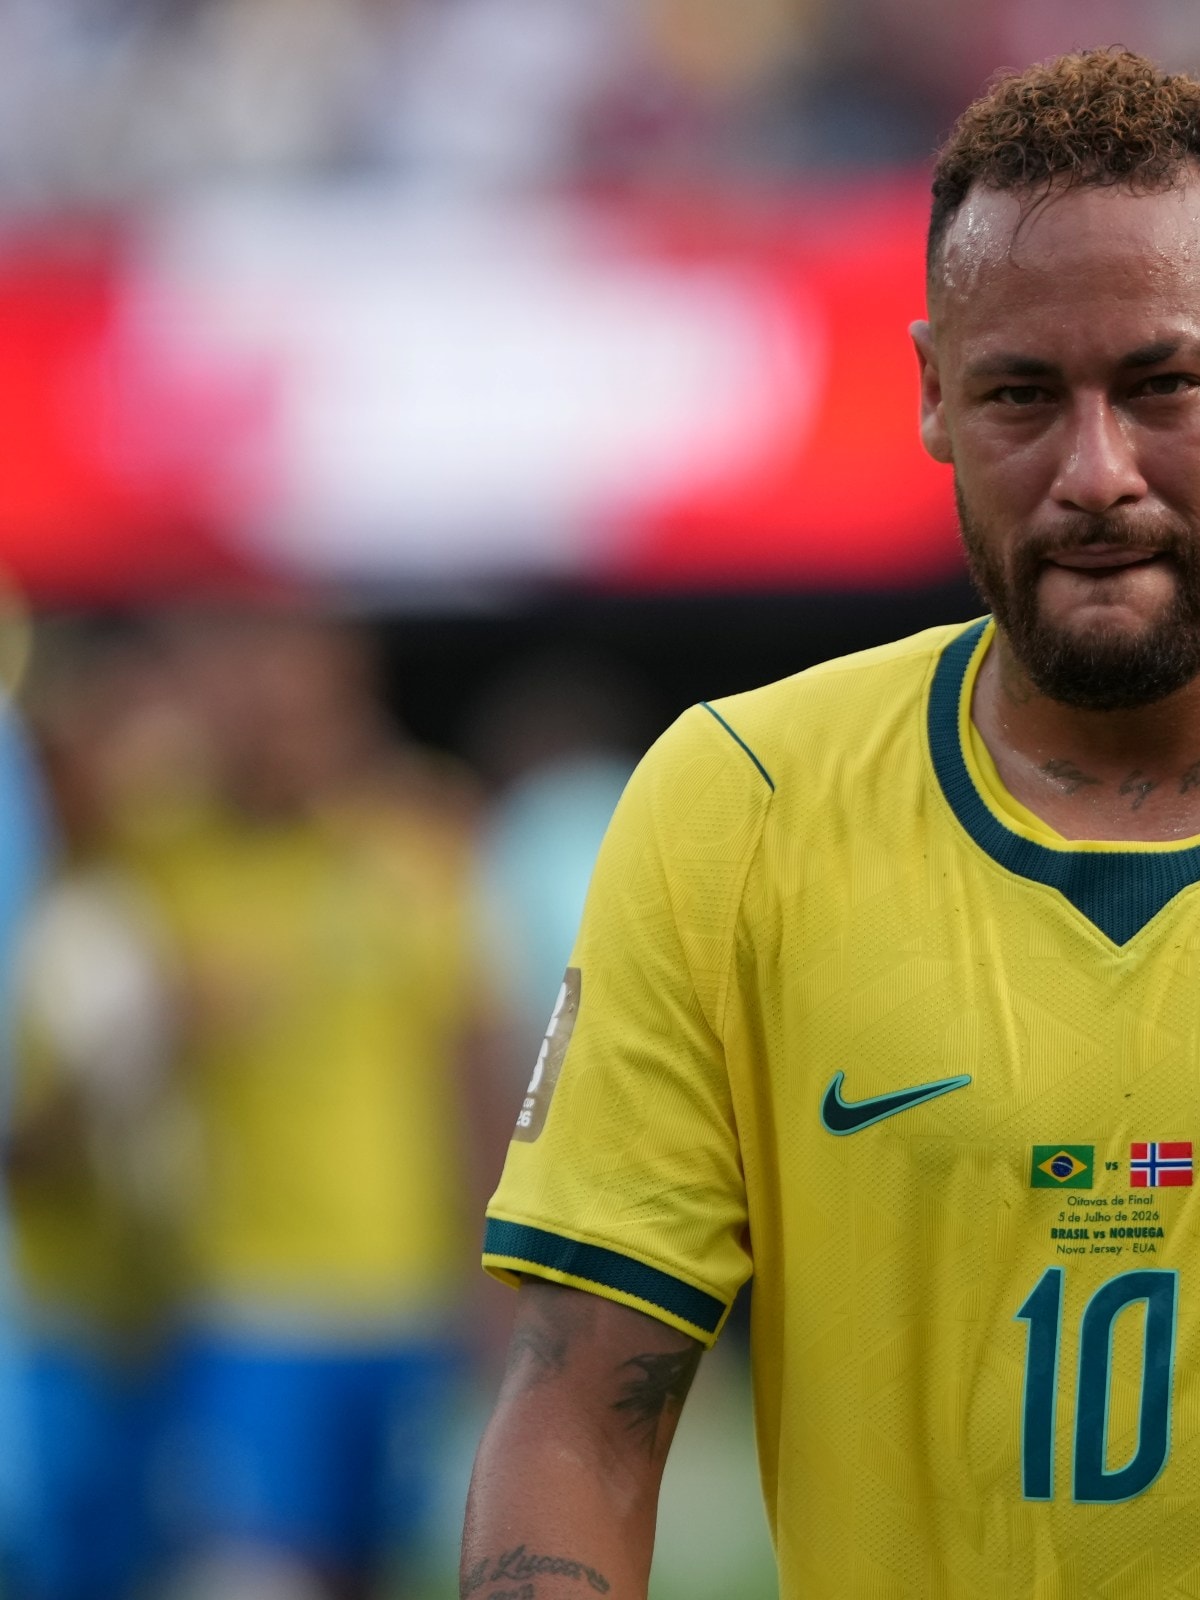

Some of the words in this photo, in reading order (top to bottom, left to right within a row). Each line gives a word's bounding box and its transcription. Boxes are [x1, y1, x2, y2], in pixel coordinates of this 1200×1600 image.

[1067, 1195, 1108, 1206] Oitavas
[1111, 1194, 1124, 1205] de
[1128, 1194, 1153, 1205] Final
[1058, 1211, 1065, 1222] 5
[1068, 1212, 1081, 1222] de
[1084, 1212, 1111, 1222] Julho
[1115, 1211, 1128, 1221] de
[1131, 1210, 1160, 1221] 2026
[1051, 1228, 1089, 1239] BRASIL
[1093, 1230, 1106, 1239] vs
[1109, 1227, 1164, 1239] NORUEGA
[1056, 1244, 1086, 1254] Nova
[1089, 1244, 1122, 1255] Jersey
[1132, 1243, 1156, 1253] EUA
[1012, 1265, 1180, 1504] 10
